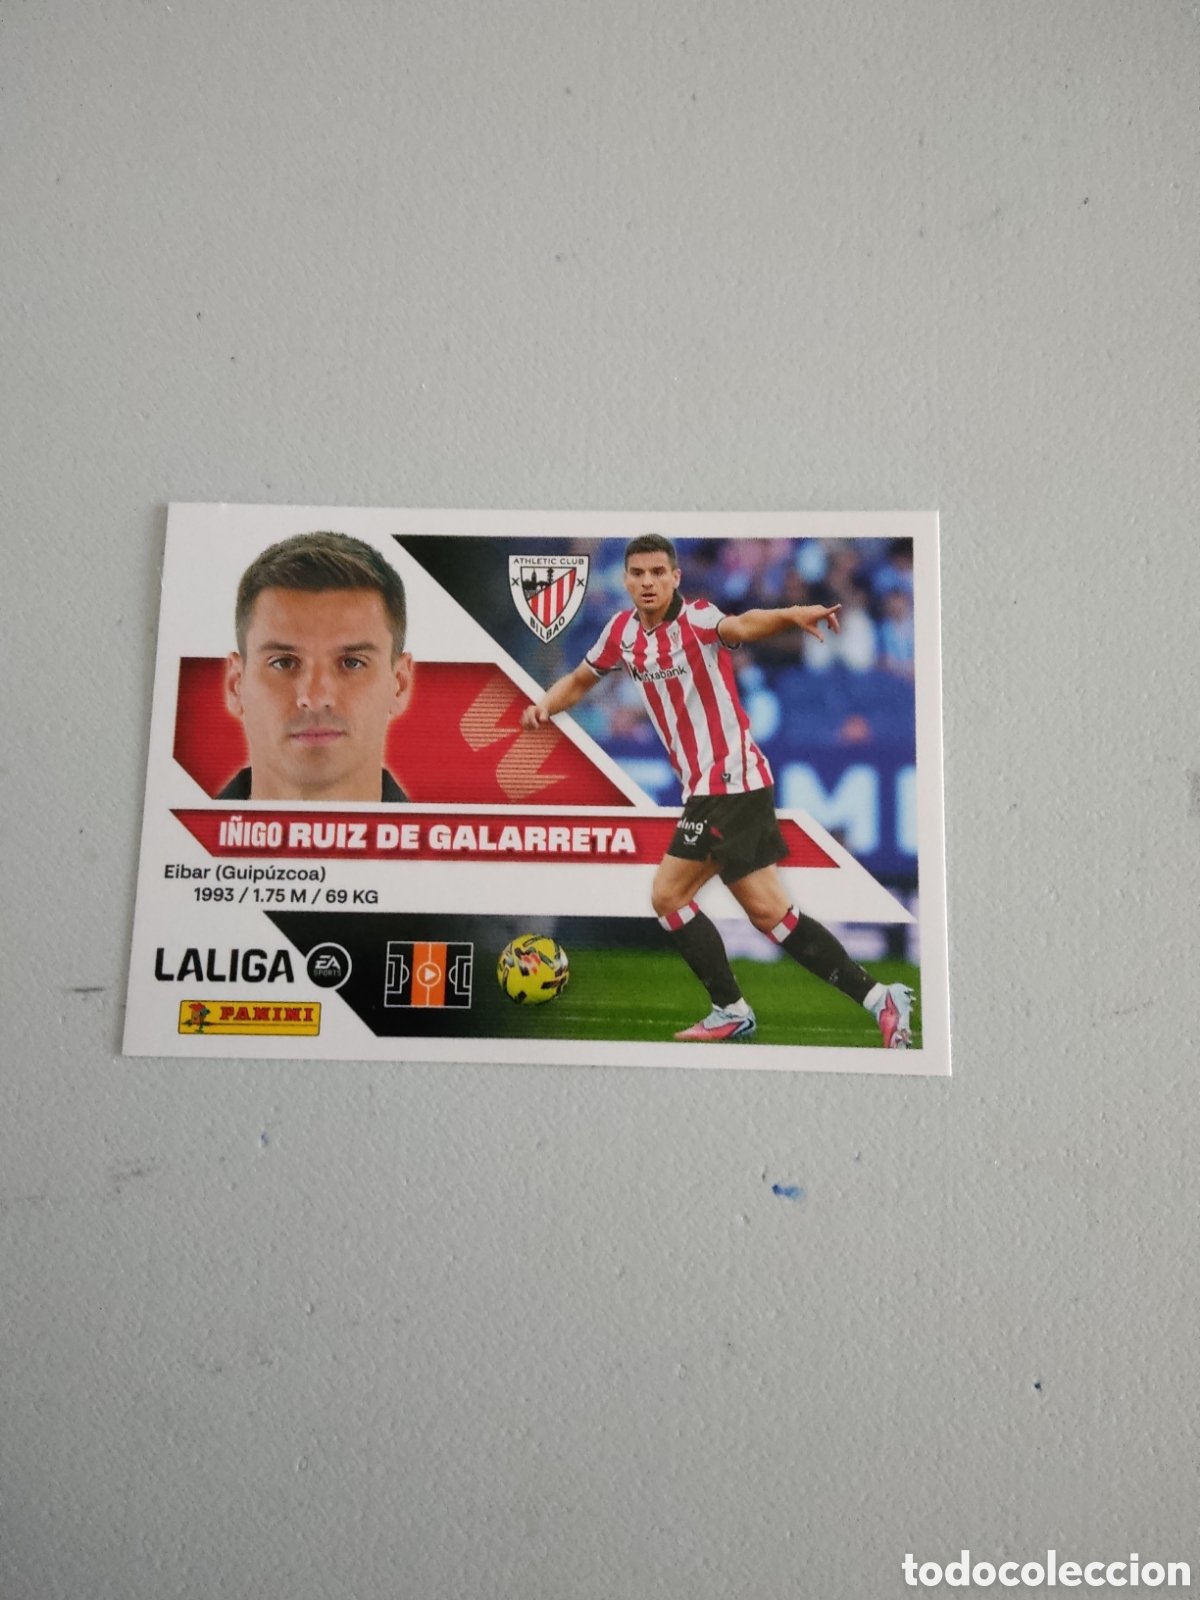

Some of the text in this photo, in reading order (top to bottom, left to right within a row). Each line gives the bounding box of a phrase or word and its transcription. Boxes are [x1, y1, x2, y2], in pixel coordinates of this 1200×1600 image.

[513, 557, 557, 565] ATHLETIC
[529, 616, 566, 640] BILBAO
[219, 815, 637, 854] IÑIGO RUIZ DE GALARRETA
[164, 864, 326, 883] Eibar (Guipúzcoa)
[194, 887, 379, 905] 1993 / 1.75 M / 69 KG
[155, 947, 295, 984] LALIGA
[315, 954, 341, 970] EA
[219, 1006, 314, 1022] PANINI
